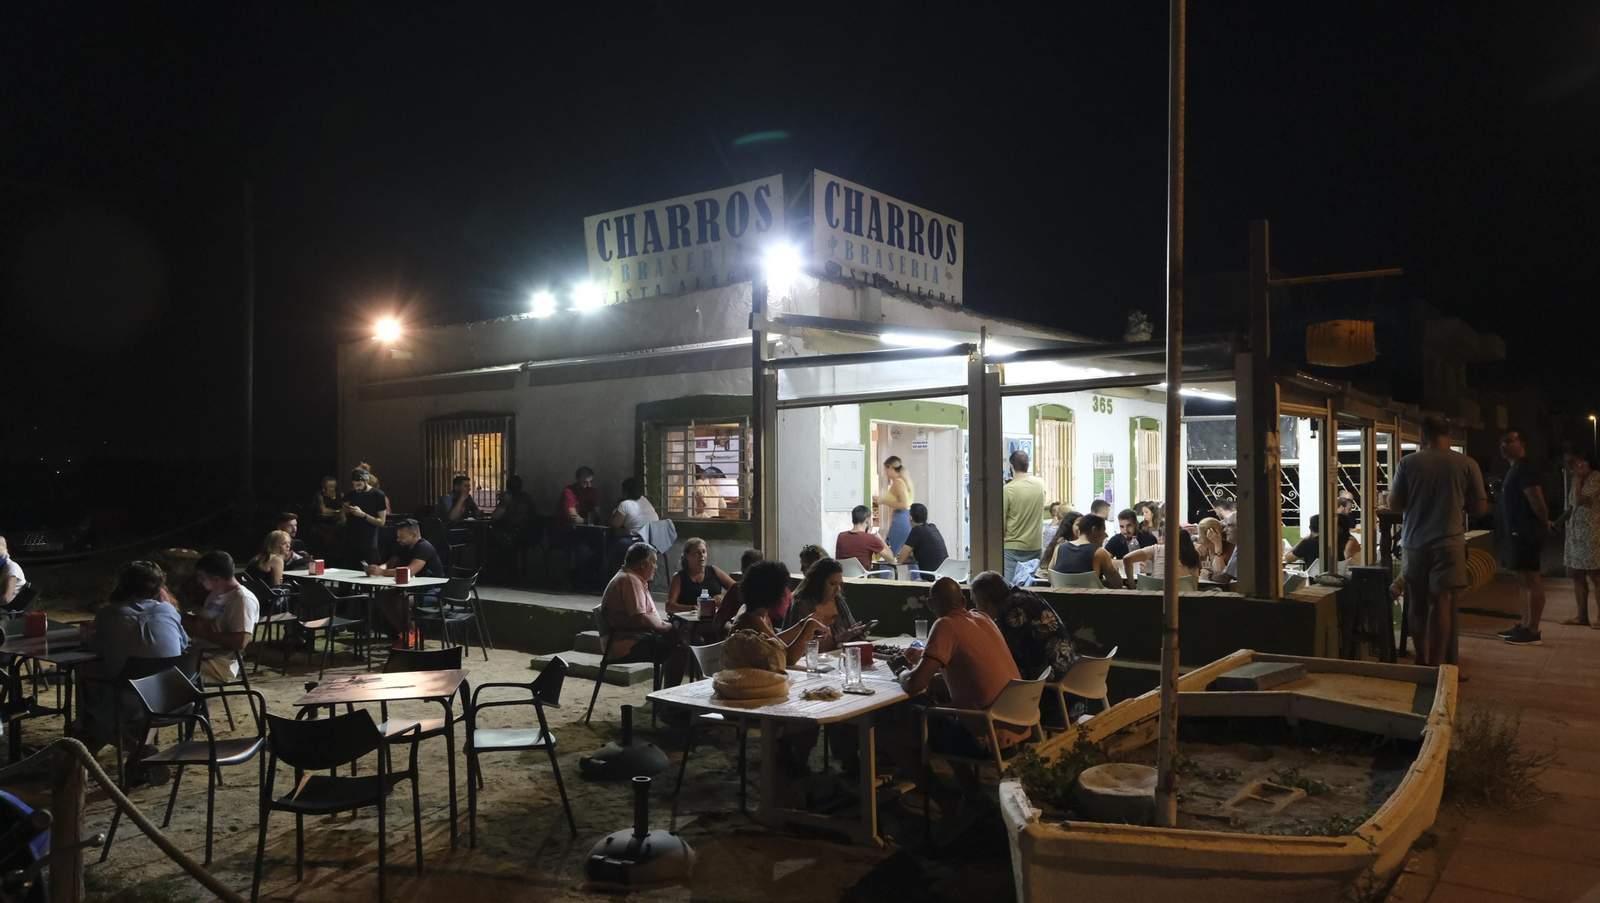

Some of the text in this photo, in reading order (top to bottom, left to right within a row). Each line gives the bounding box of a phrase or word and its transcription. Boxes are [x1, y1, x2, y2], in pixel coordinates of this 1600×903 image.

[596, 184, 772, 262] CHARROS
[825, 181, 957, 265] CHARROS
[844, 239, 939, 284] BRASERIA
[1092, 395, 1113, 414] 365
